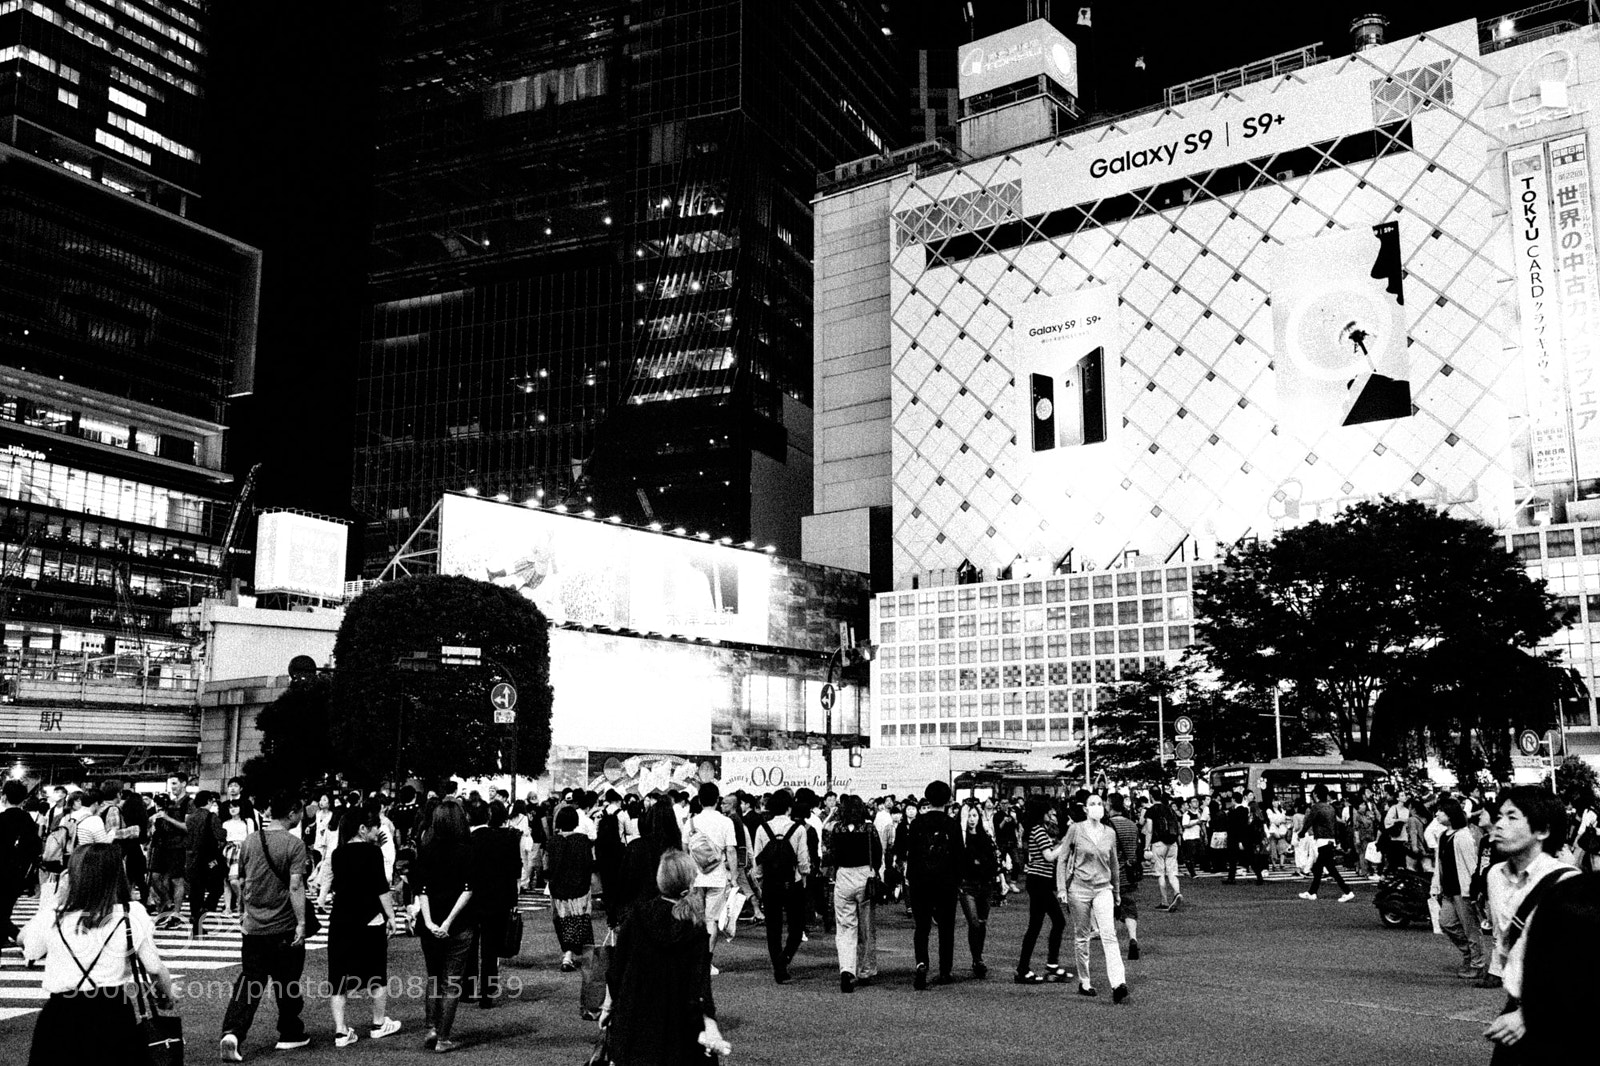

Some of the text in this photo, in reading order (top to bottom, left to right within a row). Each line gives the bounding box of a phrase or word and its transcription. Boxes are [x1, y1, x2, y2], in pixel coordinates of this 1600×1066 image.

[1089, 112, 1286, 180] Galaxy S9 S9+
[1520, 176, 1540, 243] TOKYU
[1526, 244, 1546, 300] CARD
[1029, 315, 1101, 337] Galaxy S9 S9+
[38, 711, 63, 732] 駅
